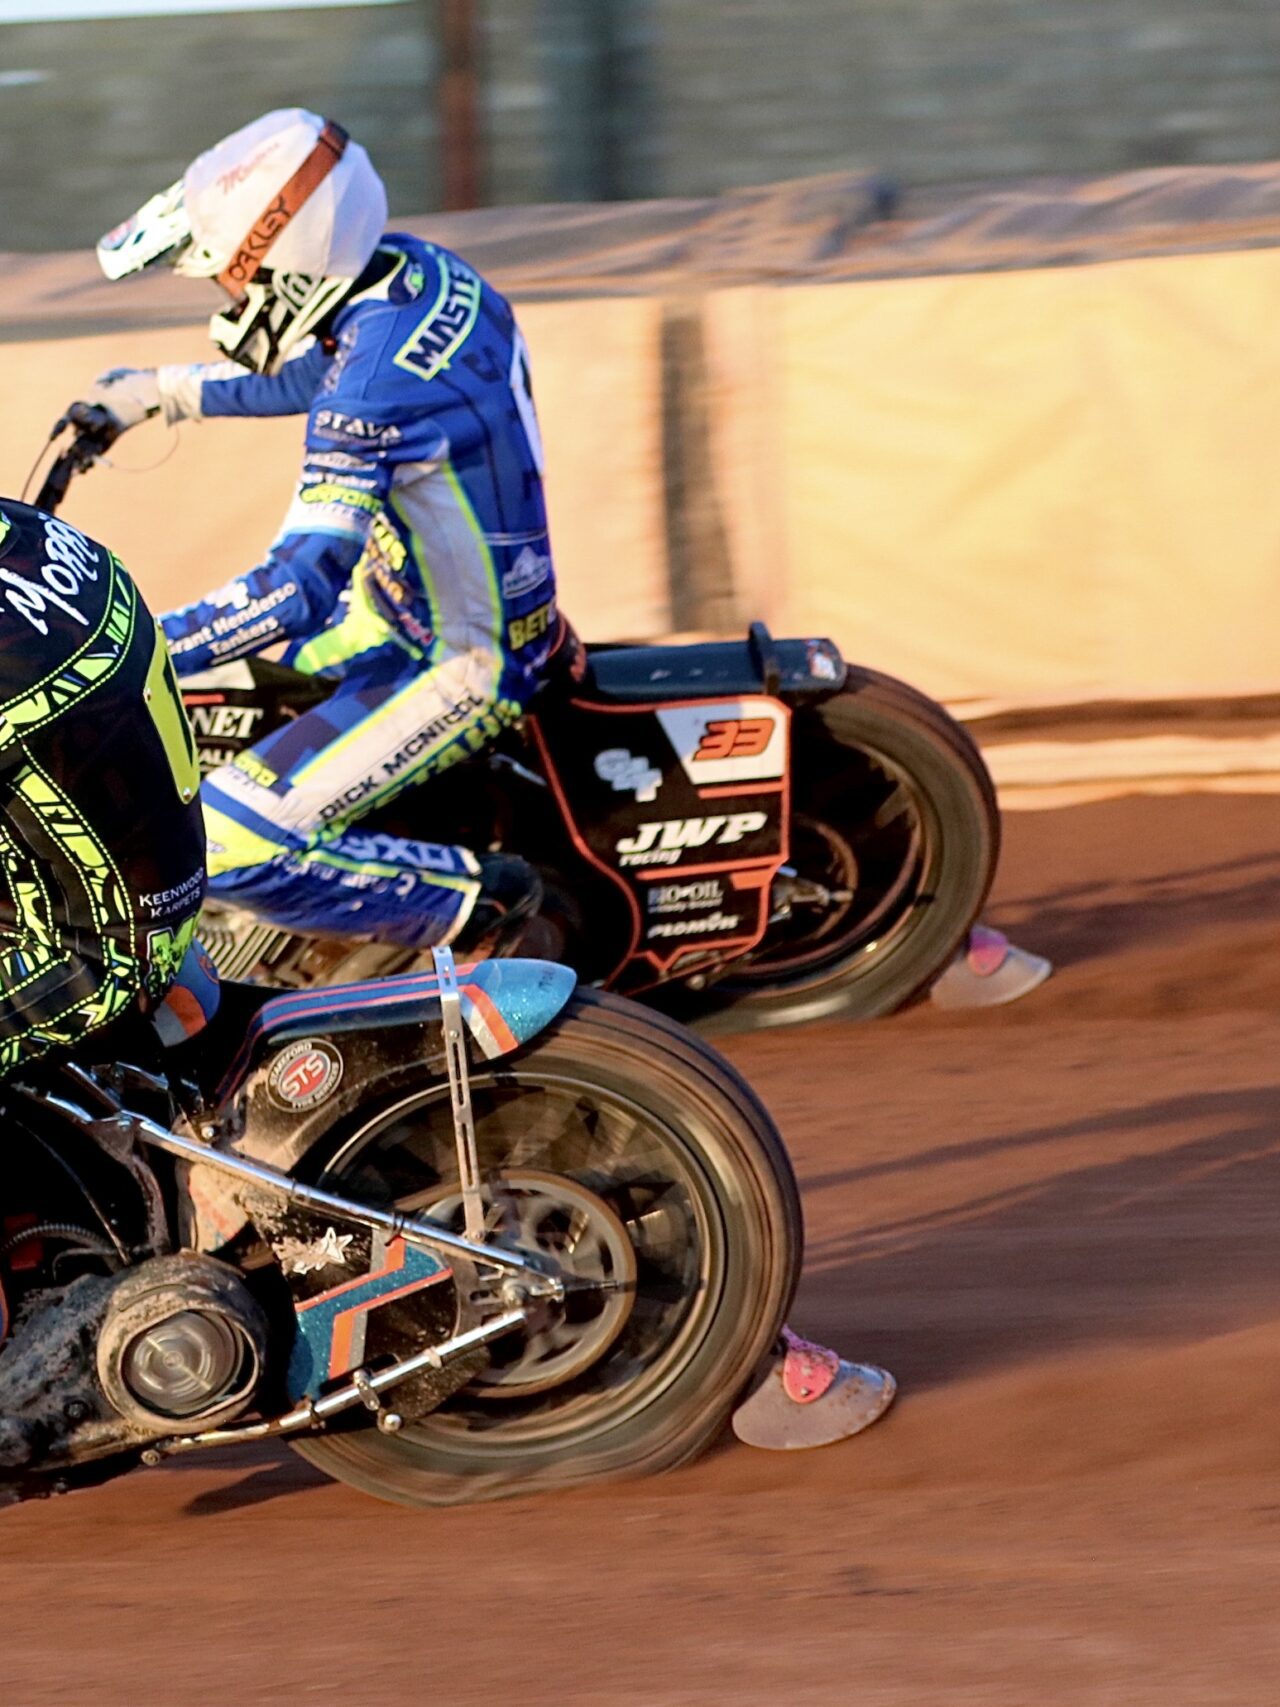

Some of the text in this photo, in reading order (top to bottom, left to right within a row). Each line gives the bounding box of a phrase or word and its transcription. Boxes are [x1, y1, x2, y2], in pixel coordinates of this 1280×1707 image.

[229, 195, 291, 281] OAKLEY
[692, 717, 776, 762] 33
[319, 775, 379, 820] DICK
[616, 811, 768, 854] JWP
[282, 1053, 324, 1100] STS
